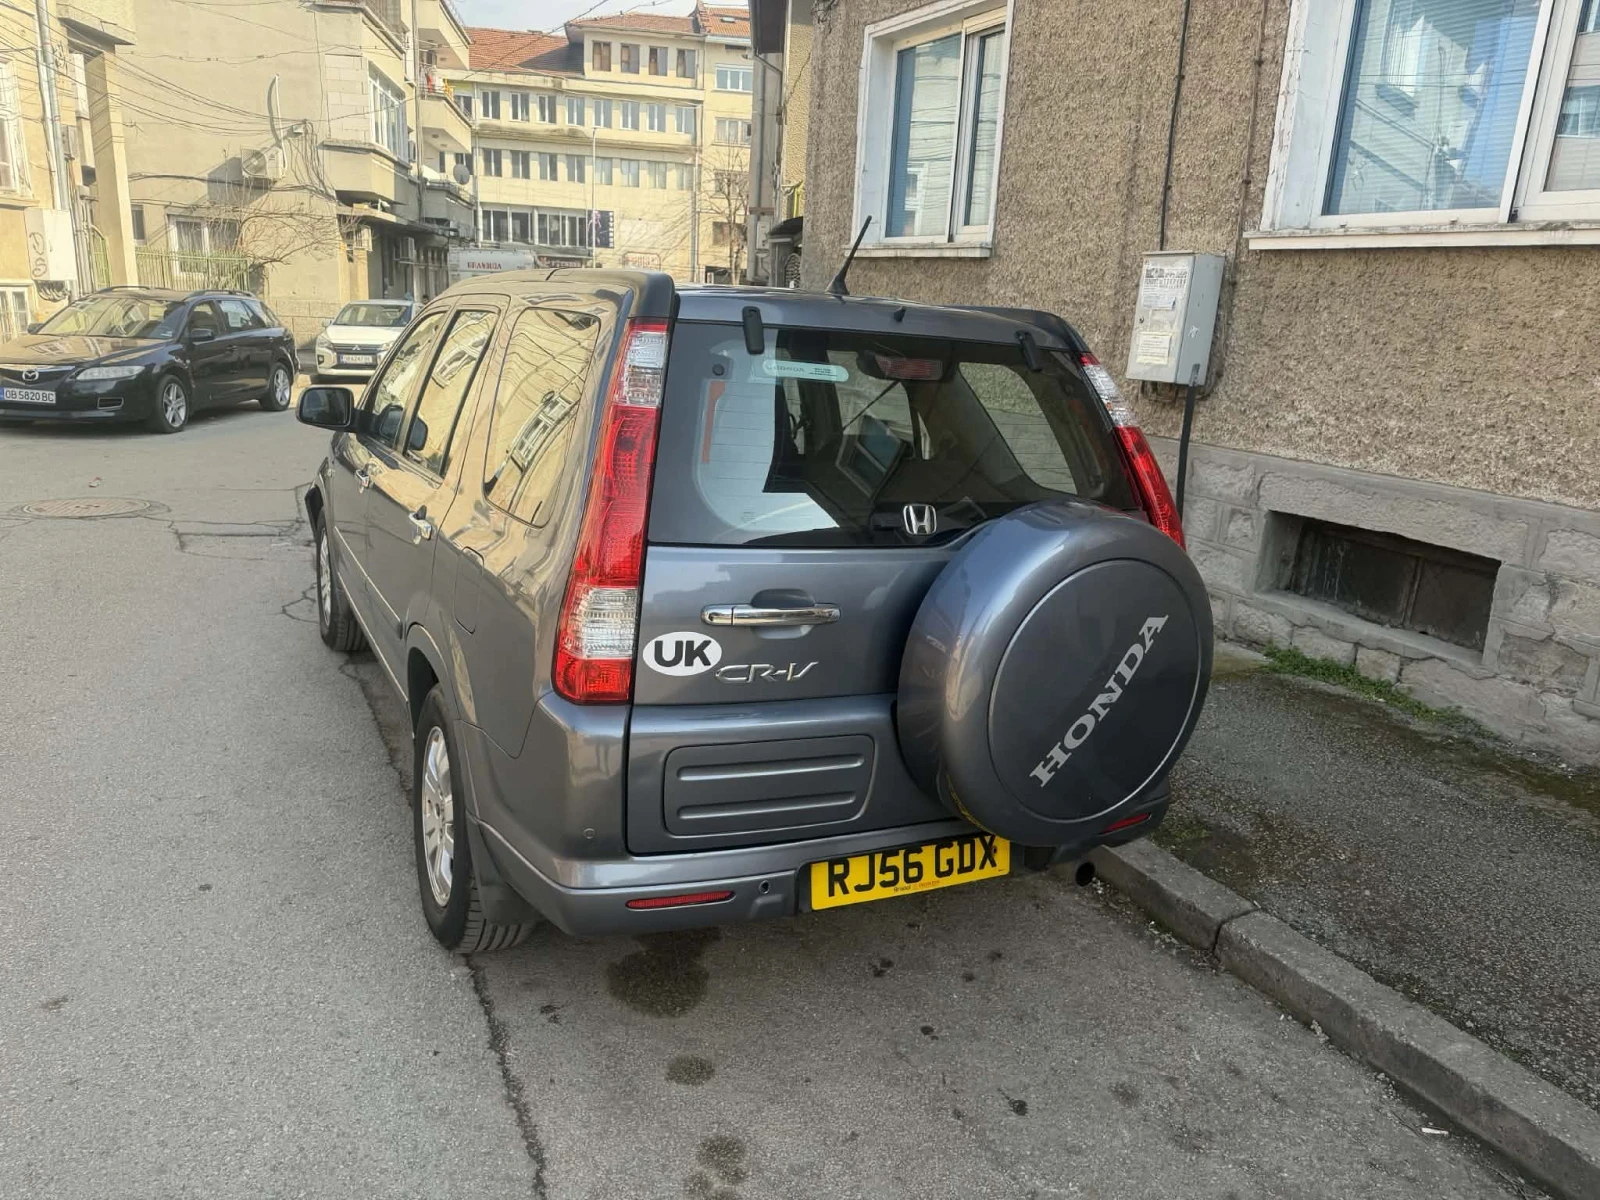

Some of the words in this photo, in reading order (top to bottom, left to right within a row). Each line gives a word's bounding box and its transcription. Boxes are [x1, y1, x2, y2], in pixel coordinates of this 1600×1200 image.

[5, 389, 17, 399] OB
[18, 391, 40, 401] 5820
[654, 640, 712, 667] UK
[715, 661, 819, 683] CR-V
[1029, 615, 1169, 787] HONDA
[828, 848, 924, 897] RJ56
[935, 834, 997, 878] GDX
